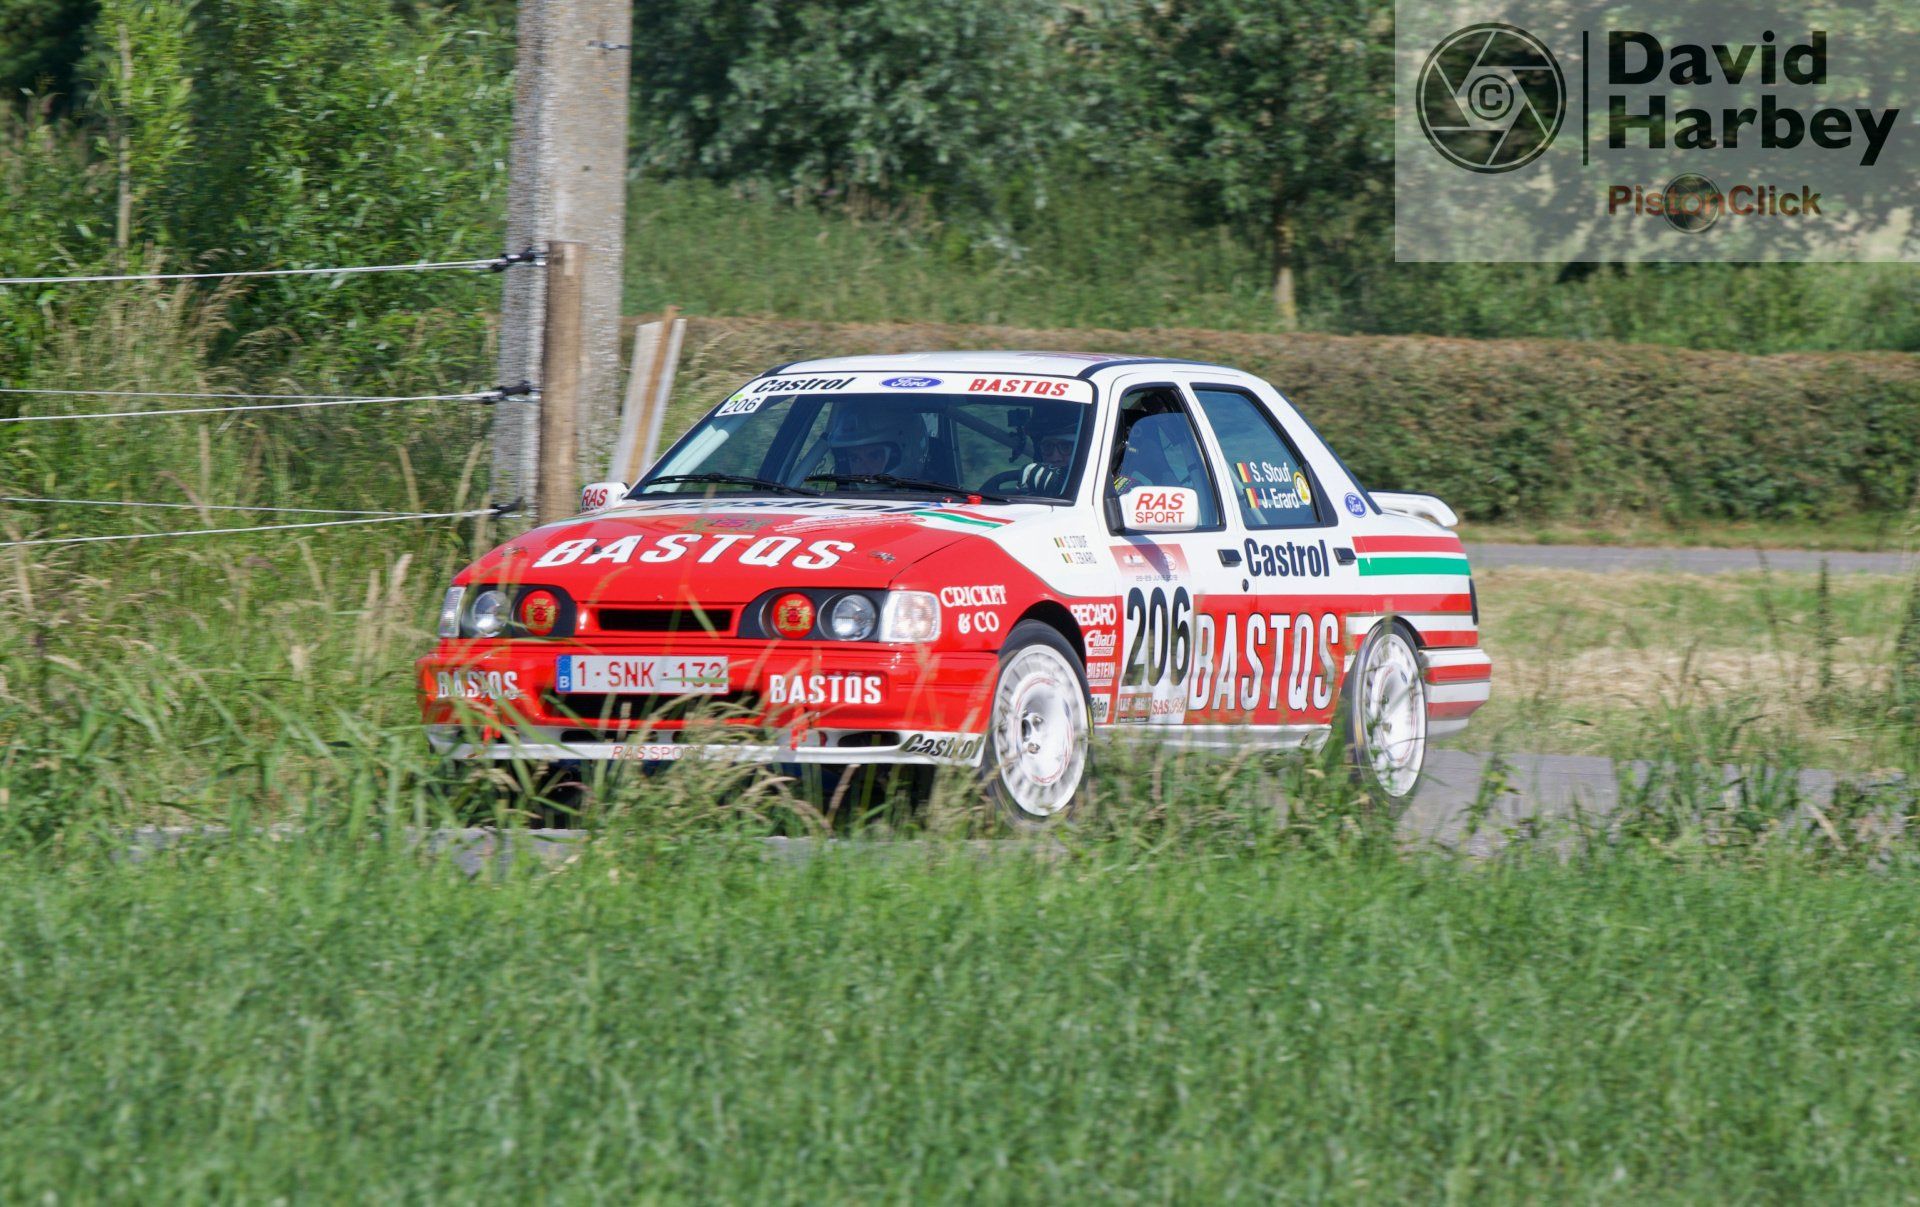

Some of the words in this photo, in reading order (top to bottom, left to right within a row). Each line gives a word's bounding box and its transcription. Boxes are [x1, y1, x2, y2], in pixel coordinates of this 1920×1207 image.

[752, 377, 857, 394] Castrol
[890, 377, 932, 388] Ford
[721, 397, 761, 415] 206
[1250, 462, 1265, 483] S.
[1261, 462, 1292, 483] Stouf
[582, 489, 608, 507] RAS
[1135, 493, 1186, 510] RAS
[1261, 488, 1272, 509] J.
[1269, 488, 1301, 509] Erard
[1135, 511, 1186, 524] SPORT
[1244, 538, 1330, 577] Castrol
[940, 585, 1007, 608] CRICKET
[957, 613, 971, 635] &
[973, 611, 1000, 633] CO
[1070, 603, 1117, 627] RECARO
[1121, 586, 1191, 687] 206
[559, 676, 570, 689] B
